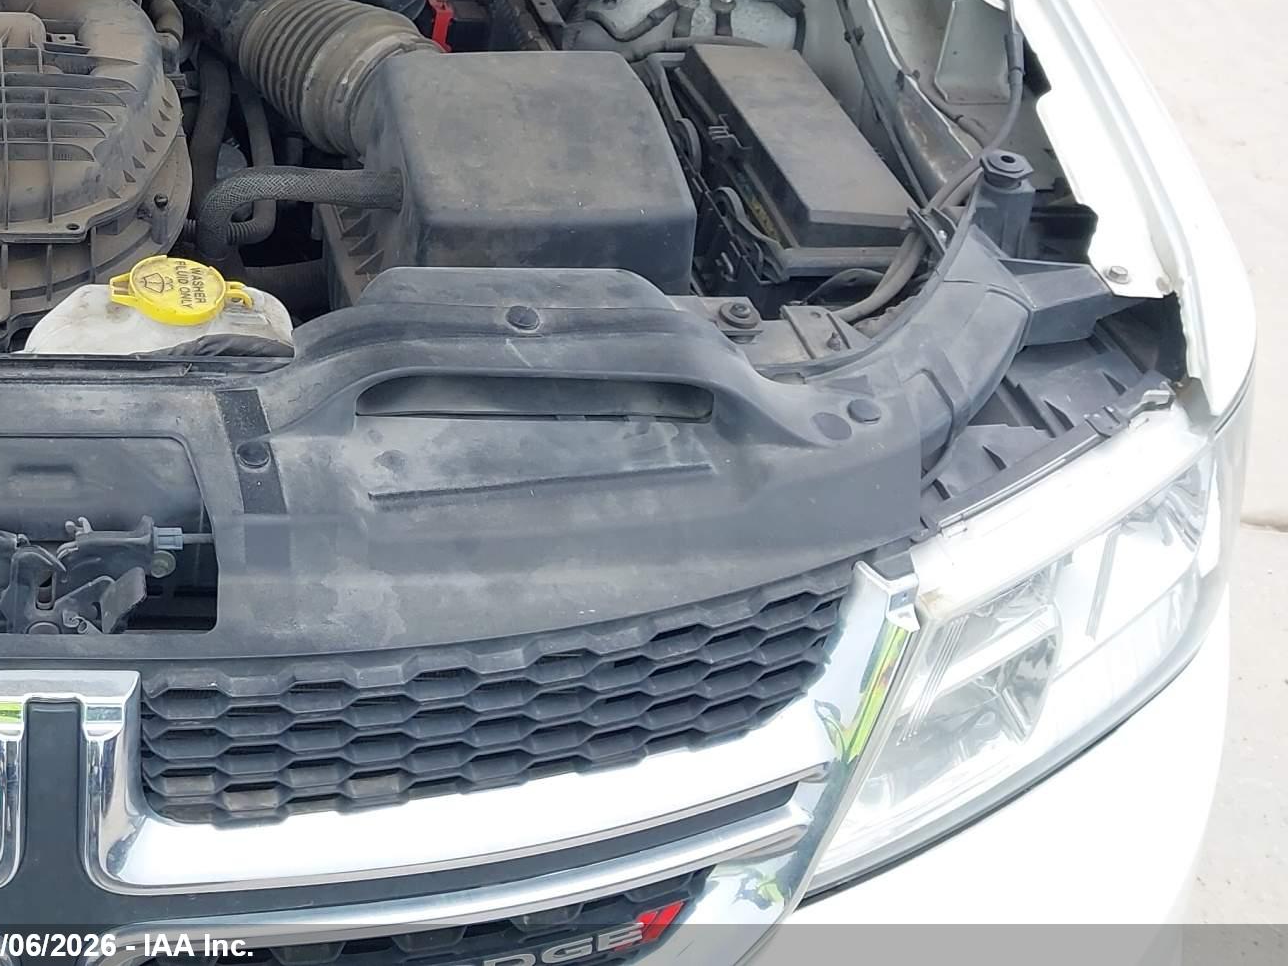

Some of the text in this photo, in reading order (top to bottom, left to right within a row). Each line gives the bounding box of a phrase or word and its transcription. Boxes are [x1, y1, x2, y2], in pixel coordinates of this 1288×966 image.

[175, 260, 193, 309] FLUID ONLY
[189, 266, 207, 304] WASHER
